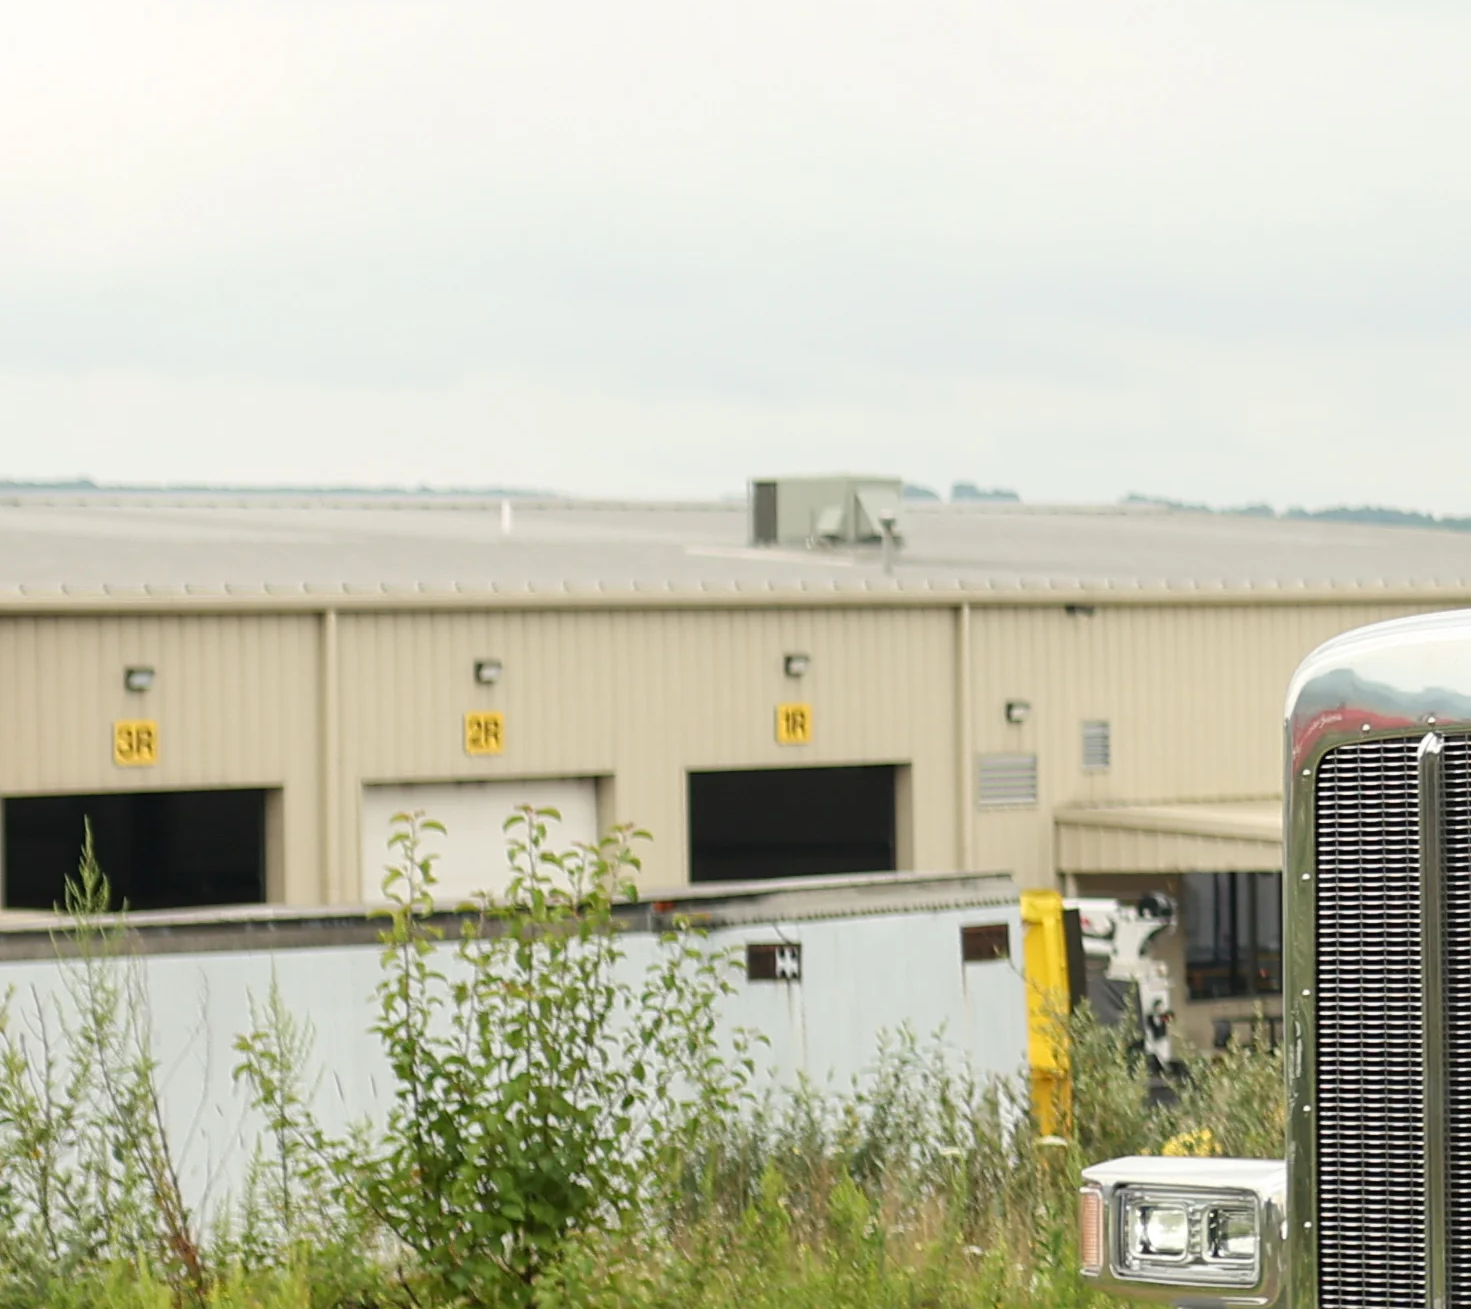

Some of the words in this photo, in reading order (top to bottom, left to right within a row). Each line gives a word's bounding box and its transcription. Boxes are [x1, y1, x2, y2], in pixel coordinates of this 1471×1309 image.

[468, 715, 501, 749] 2R
[784, 708, 807, 740] 1R
[116, 724, 153, 761] 3R
